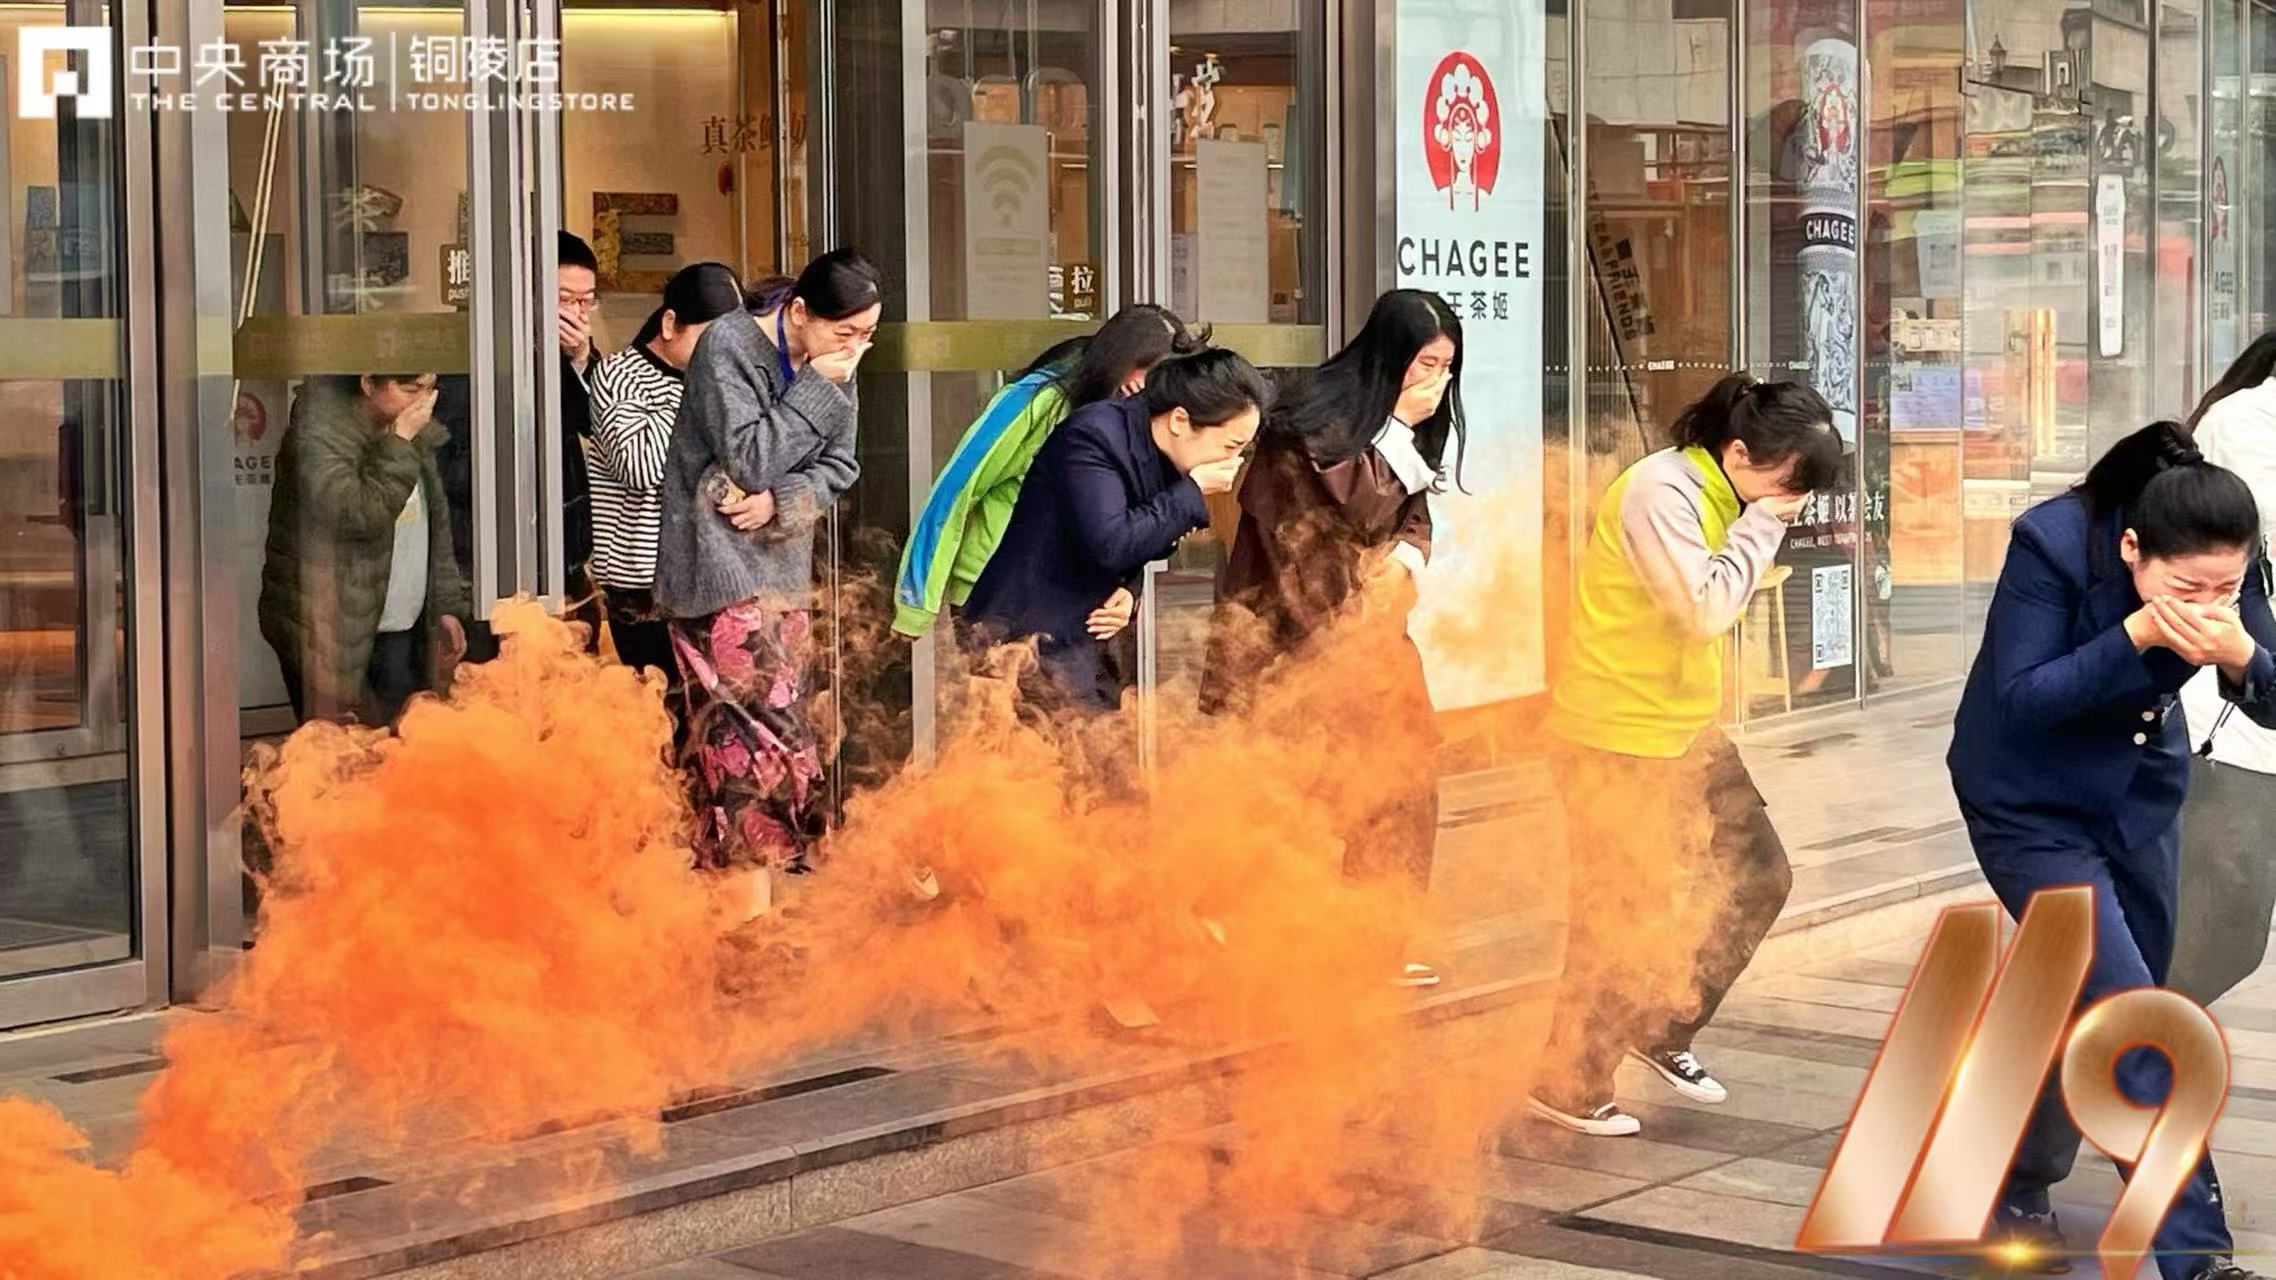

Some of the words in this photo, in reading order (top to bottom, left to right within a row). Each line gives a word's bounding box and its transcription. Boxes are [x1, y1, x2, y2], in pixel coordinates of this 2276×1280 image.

[1806, 219, 1854, 245] CHAGEE
[1397, 236, 1530, 279] CHAGEE
[1071, 265, 1095, 294] 拉
[1436, 290, 1509, 320] 王茶姬
